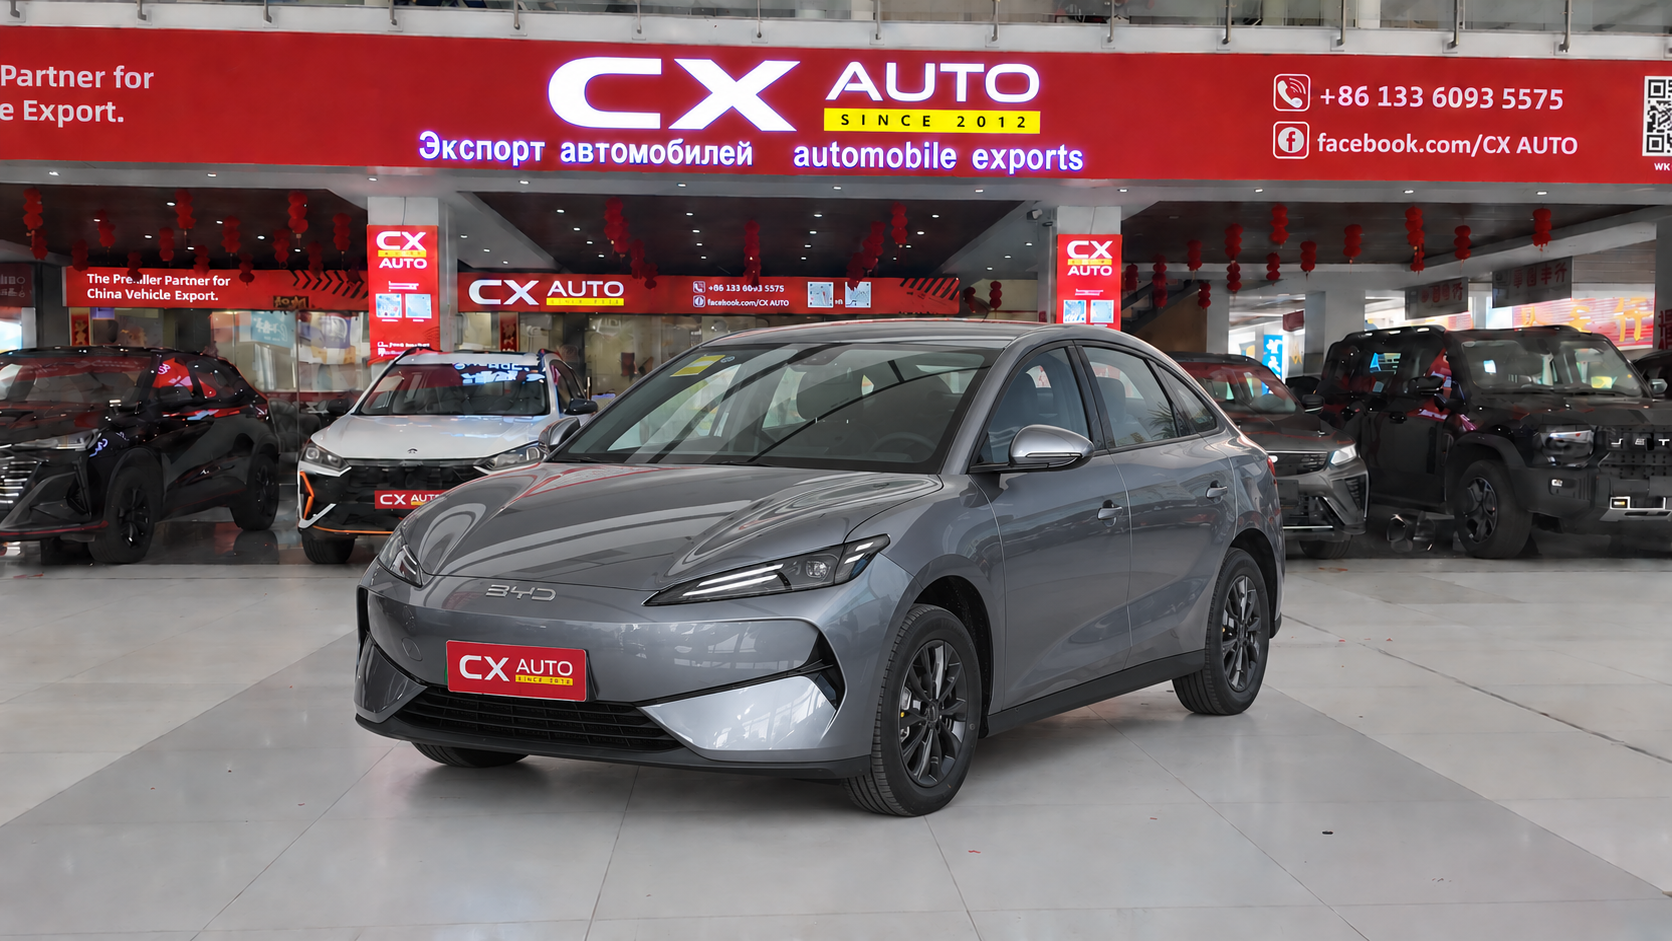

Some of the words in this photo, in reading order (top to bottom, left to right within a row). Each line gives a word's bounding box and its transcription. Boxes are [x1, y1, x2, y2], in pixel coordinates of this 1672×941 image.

[0, 65, 106, 88] Partner
[113, 65, 155, 89] for
[547, 56, 801, 132] CX
[825, 61, 1040, 103] AUTO
[1320, 85, 1370, 107] +86
[1377, 86, 1424, 108] 133
[1431, 87, 1494, 109] 6093
[1501, 88, 1564, 110] 5575
[23, 100, 124, 128] Export.
[840, 114, 931, 127] SINCE
[956, 115, 1026, 129] 2012
[418, 130, 546, 167] Экспорт
[559, 138, 753, 166] автомобилей
[1317, 133, 1511, 158] facebook.com/CX
[1516, 136, 1578, 155] AUTO
[793, 141, 957, 170] automobile
[971, 144, 1084, 175] exports
[376, 231, 427, 250] CX
[1066, 240, 1113, 259] CX
[378, 258, 428, 269] AUTO
[1067, 265, 1113, 276] AUTO
[87, 273, 110, 284] The
[165, 275, 211, 286] Partner
[212, 275, 231, 286] for
[725, 284, 741, 292] 133
[87, 288, 122, 299] China
[125, 288, 171, 300] Vehicle
[175, 290, 219, 303] Export.
[468, 279, 539, 306] CX
[547, 280, 625, 297] AUTO
[769, 299, 790, 307] AUTO
[380, 494, 406, 505] CX
[410, 493, 441, 502] AUT
[485, 583, 557, 602] BYD
[459, 654, 511, 682] CX
[516, 658, 573, 676] AUTO
